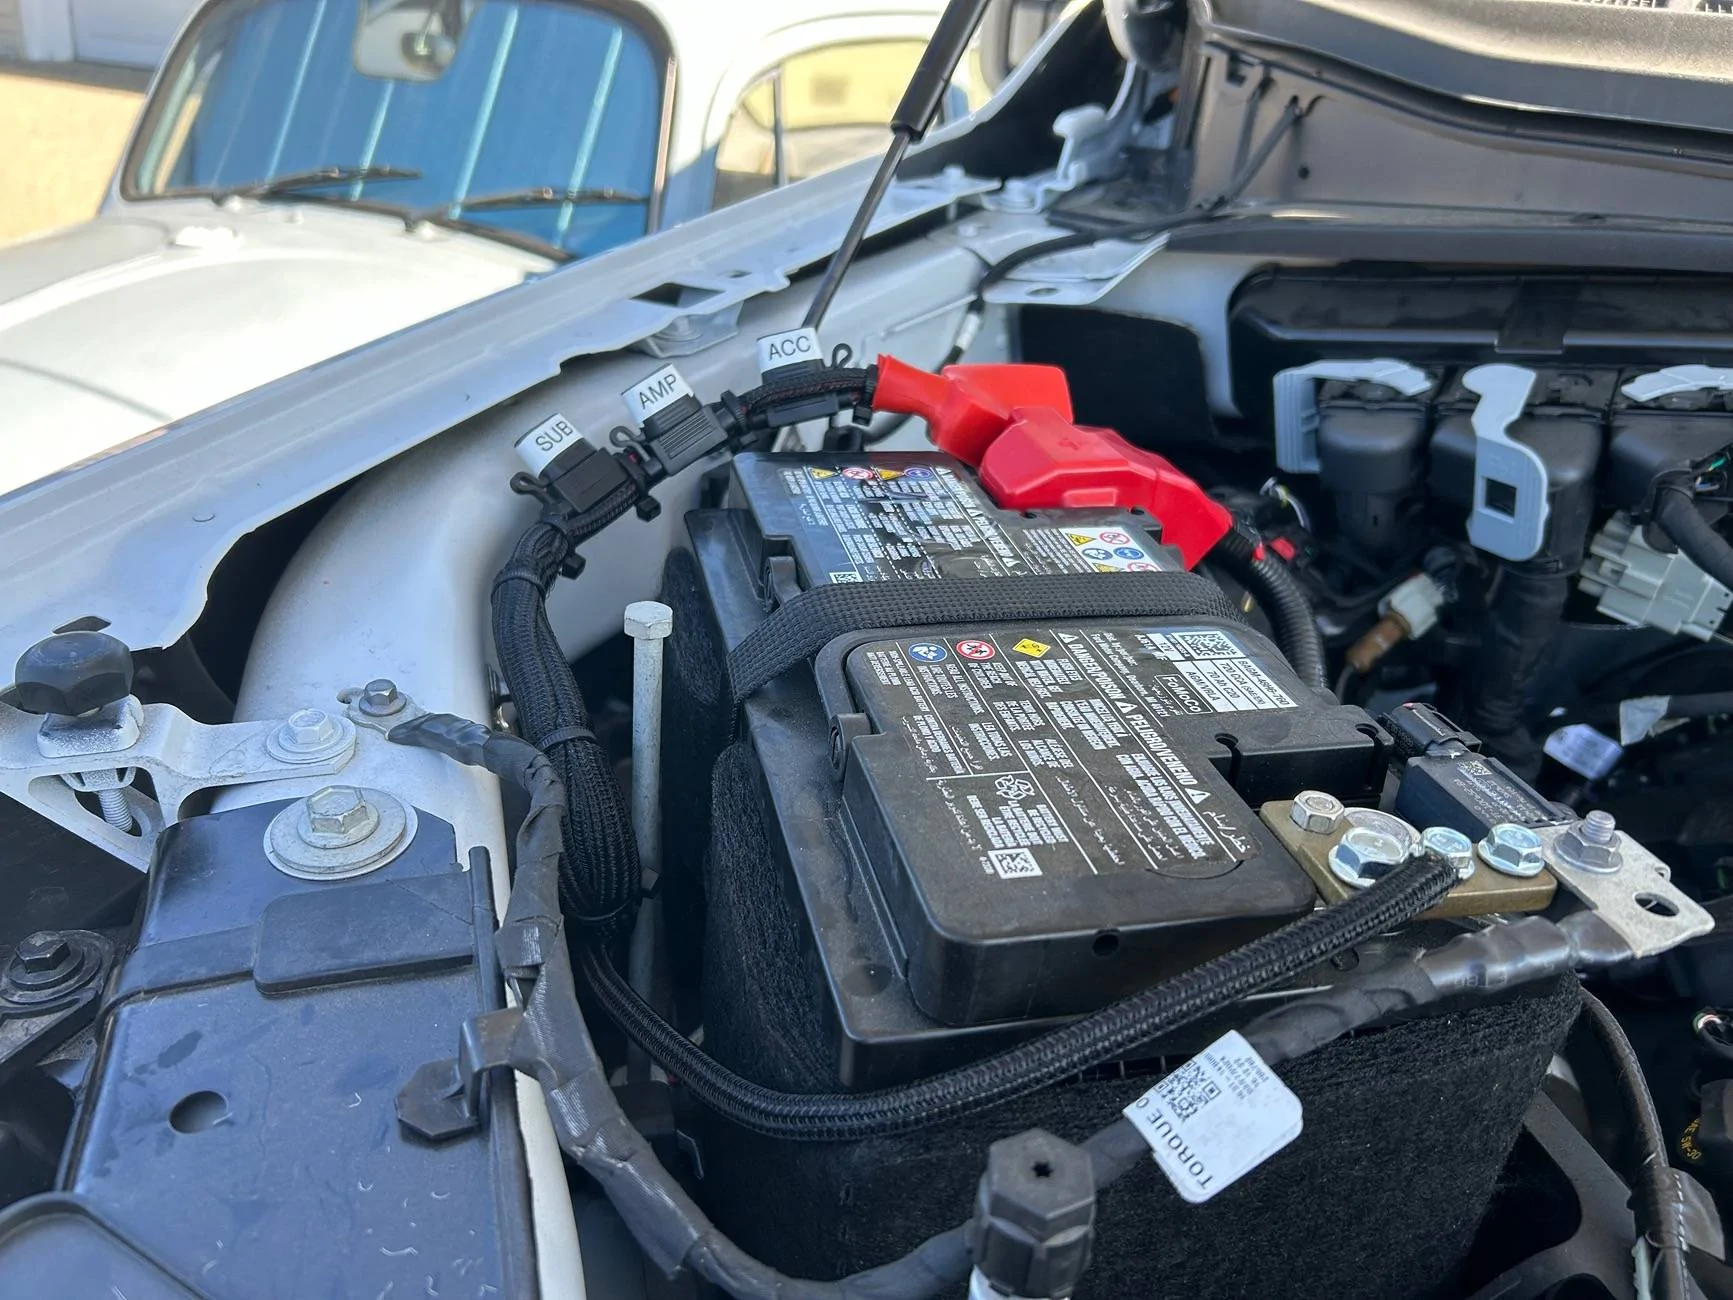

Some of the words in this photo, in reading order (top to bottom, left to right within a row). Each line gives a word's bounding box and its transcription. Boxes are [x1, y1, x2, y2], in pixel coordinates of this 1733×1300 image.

[769, 336, 812, 361] ACC
[639, 373, 678, 410] AMP
[535, 420, 574, 452] SUB
[1089, 634, 1105, 642] Ford
[1157, 642, 1174, 651] 12V
[1065, 643, 1127, 699] DANGER/POISON
[1205, 670, 1220, 678] 70
[1213, 678, 1228, 686] Ah
[1222, 687, 1240, 698] C20
[1218, 663, 1236, 672] 720
[1229, 673, 1249, 684] CCA
[1160, 676, 1205, 711] FoMoCo
[1122, 714, 1199, 785] PELIGRO/VENENO
[1147, 1108, 1214, 1190] TORQUE
